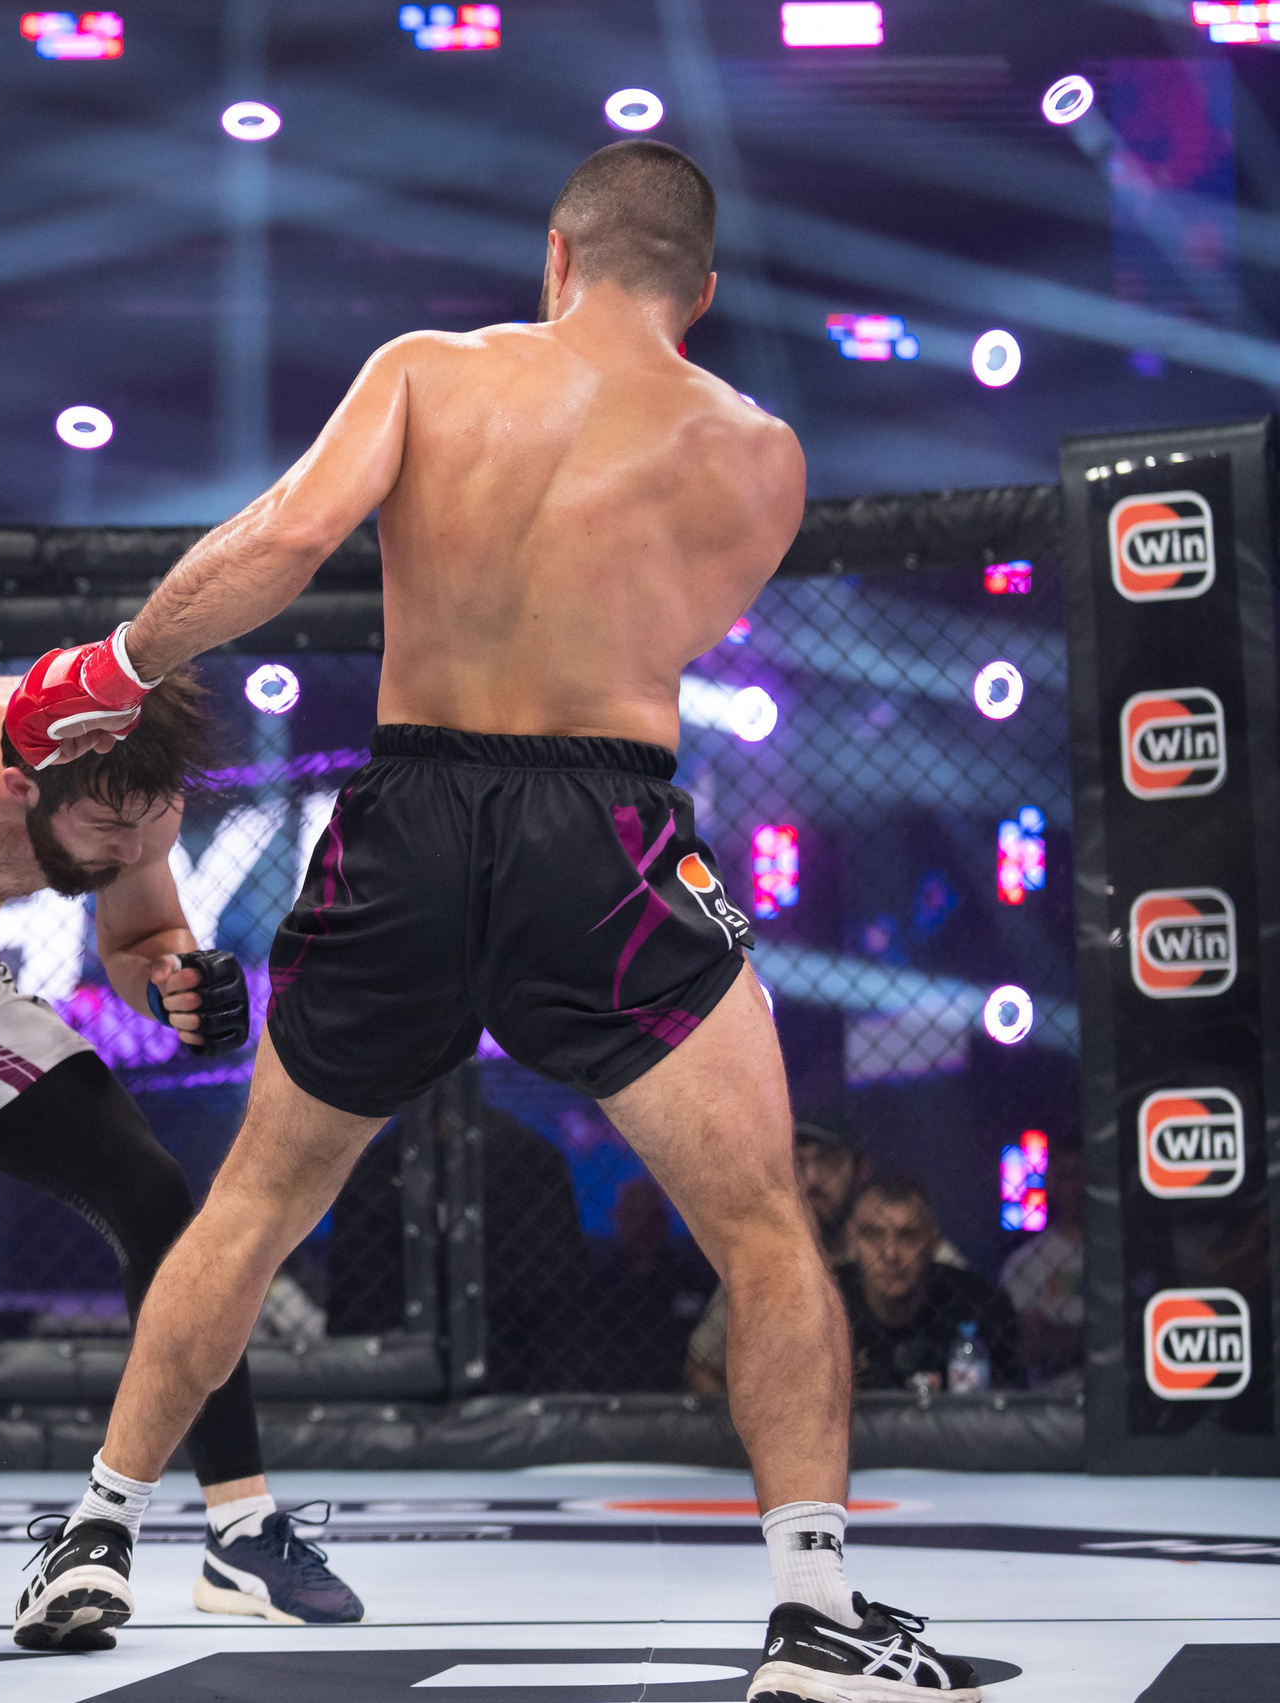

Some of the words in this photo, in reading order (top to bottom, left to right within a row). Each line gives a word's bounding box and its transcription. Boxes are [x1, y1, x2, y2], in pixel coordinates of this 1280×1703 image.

[1133, 530, 1206, 564] Win
[1145, 725, 1217, 761] Win
[1153, 926, 1227, 960] Win
[1162, 1125, 1235, 1160] Win
[1168, 1326, 1241, 1362] Win
